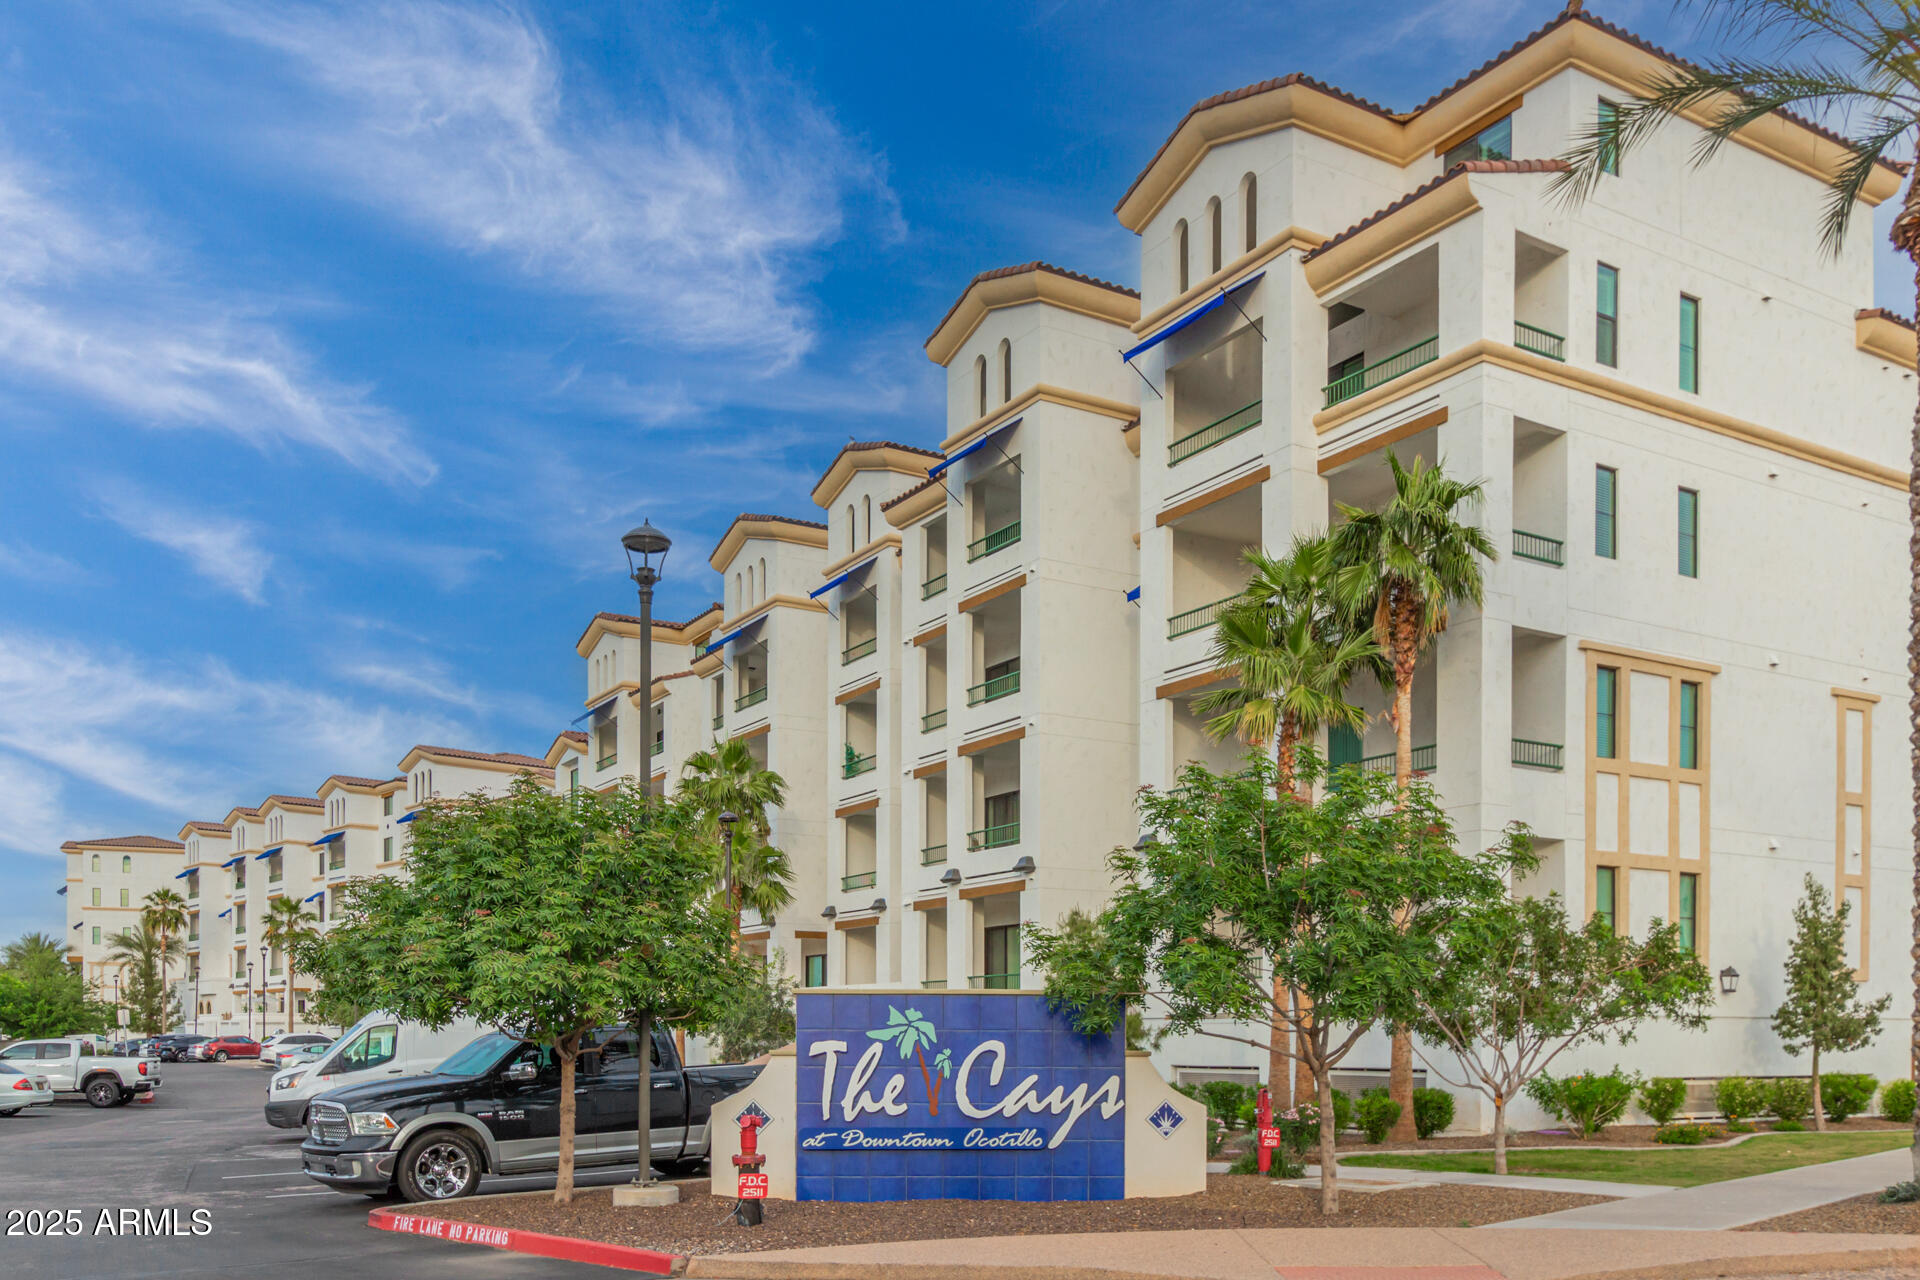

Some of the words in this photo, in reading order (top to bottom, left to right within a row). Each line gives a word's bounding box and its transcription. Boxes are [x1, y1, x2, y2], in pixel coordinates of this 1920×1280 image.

[808, 1039, 908, 1123] The
[955, 1040, 1126, 1150] Cays
[802, 1132, 838, 1148] at
[841, 1128, 954, 1148] Downtown
[963, 1127, 1044, 1148] Ocotillo
[742, 1187, 764, 1197] 2511
[393, 1215, 415, 1232] FIRE
[419, 1219, 444, 1236] LANE
[448, 1223, 463, 1239] NO
[465, 1226, 509, 1245] PARKING
